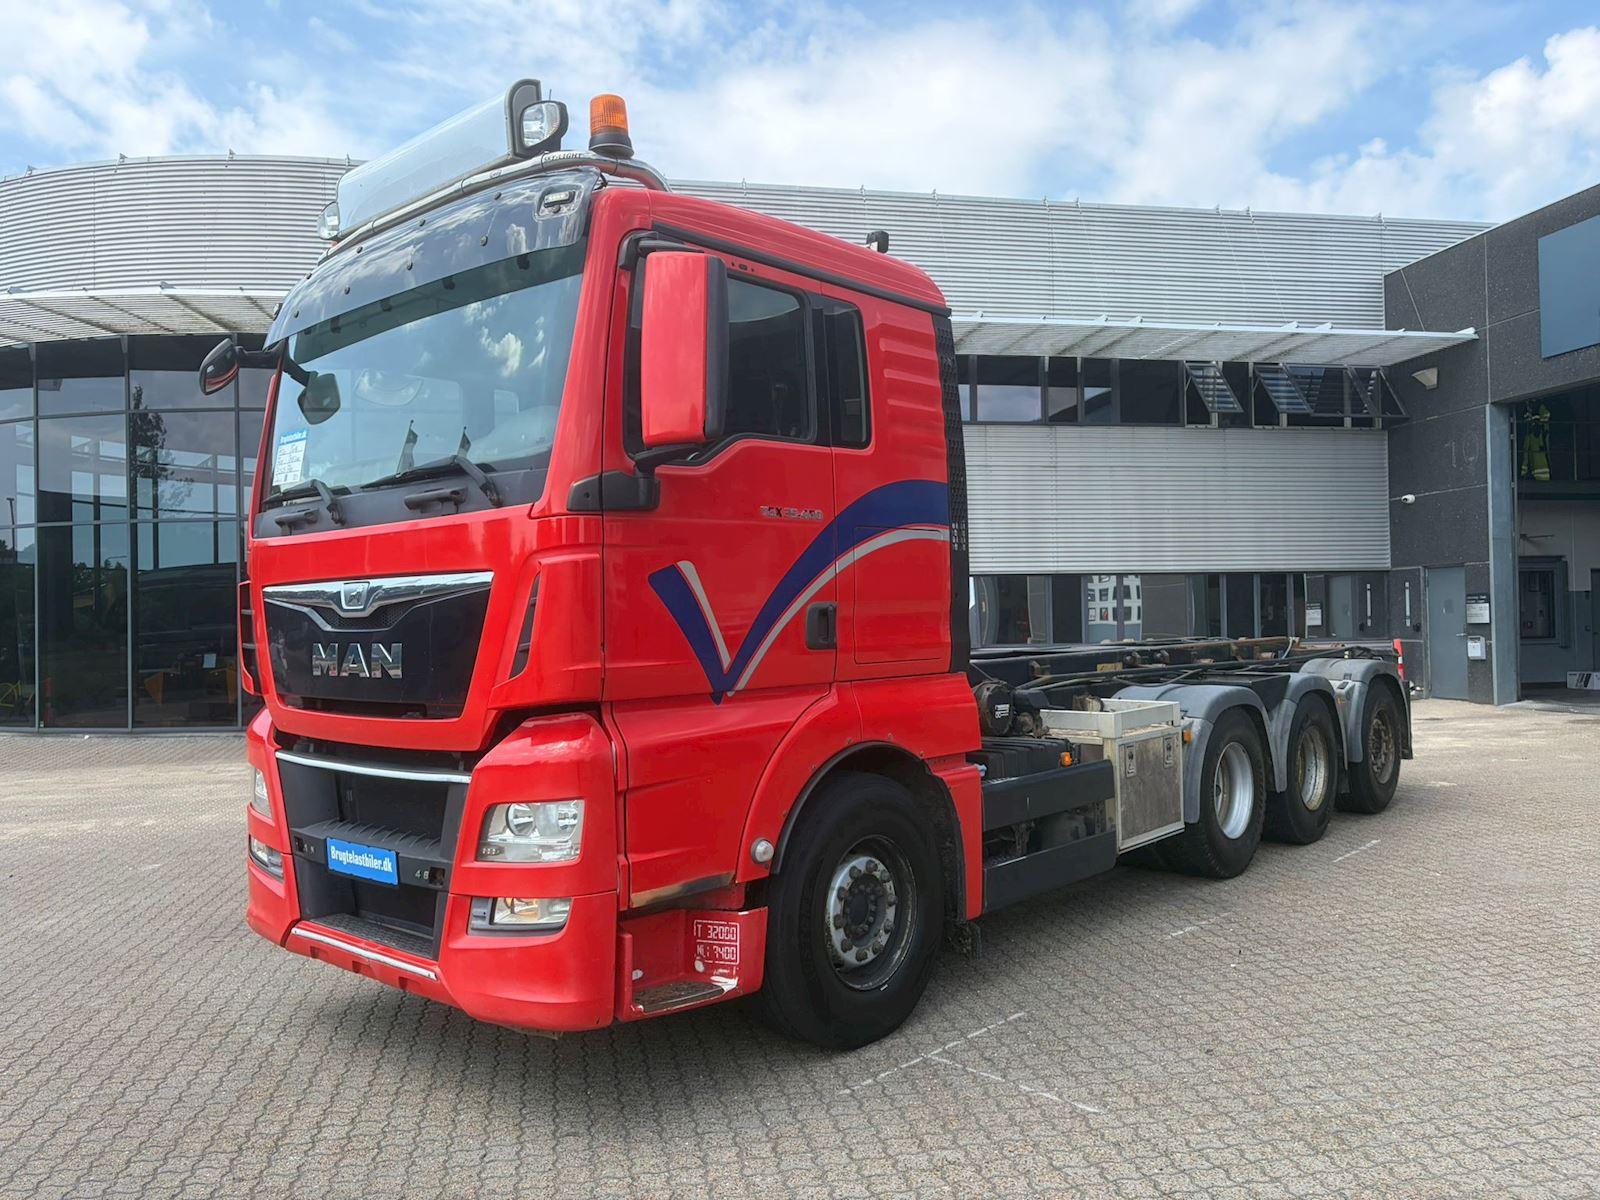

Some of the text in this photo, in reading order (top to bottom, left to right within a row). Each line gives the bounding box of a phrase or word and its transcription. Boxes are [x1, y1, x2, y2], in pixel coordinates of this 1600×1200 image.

[312, 643, 402, 679] MAN
[330, 845, 393, 873] Brugtelastbiler.dk
[707, 925, 736, 940] 32000
